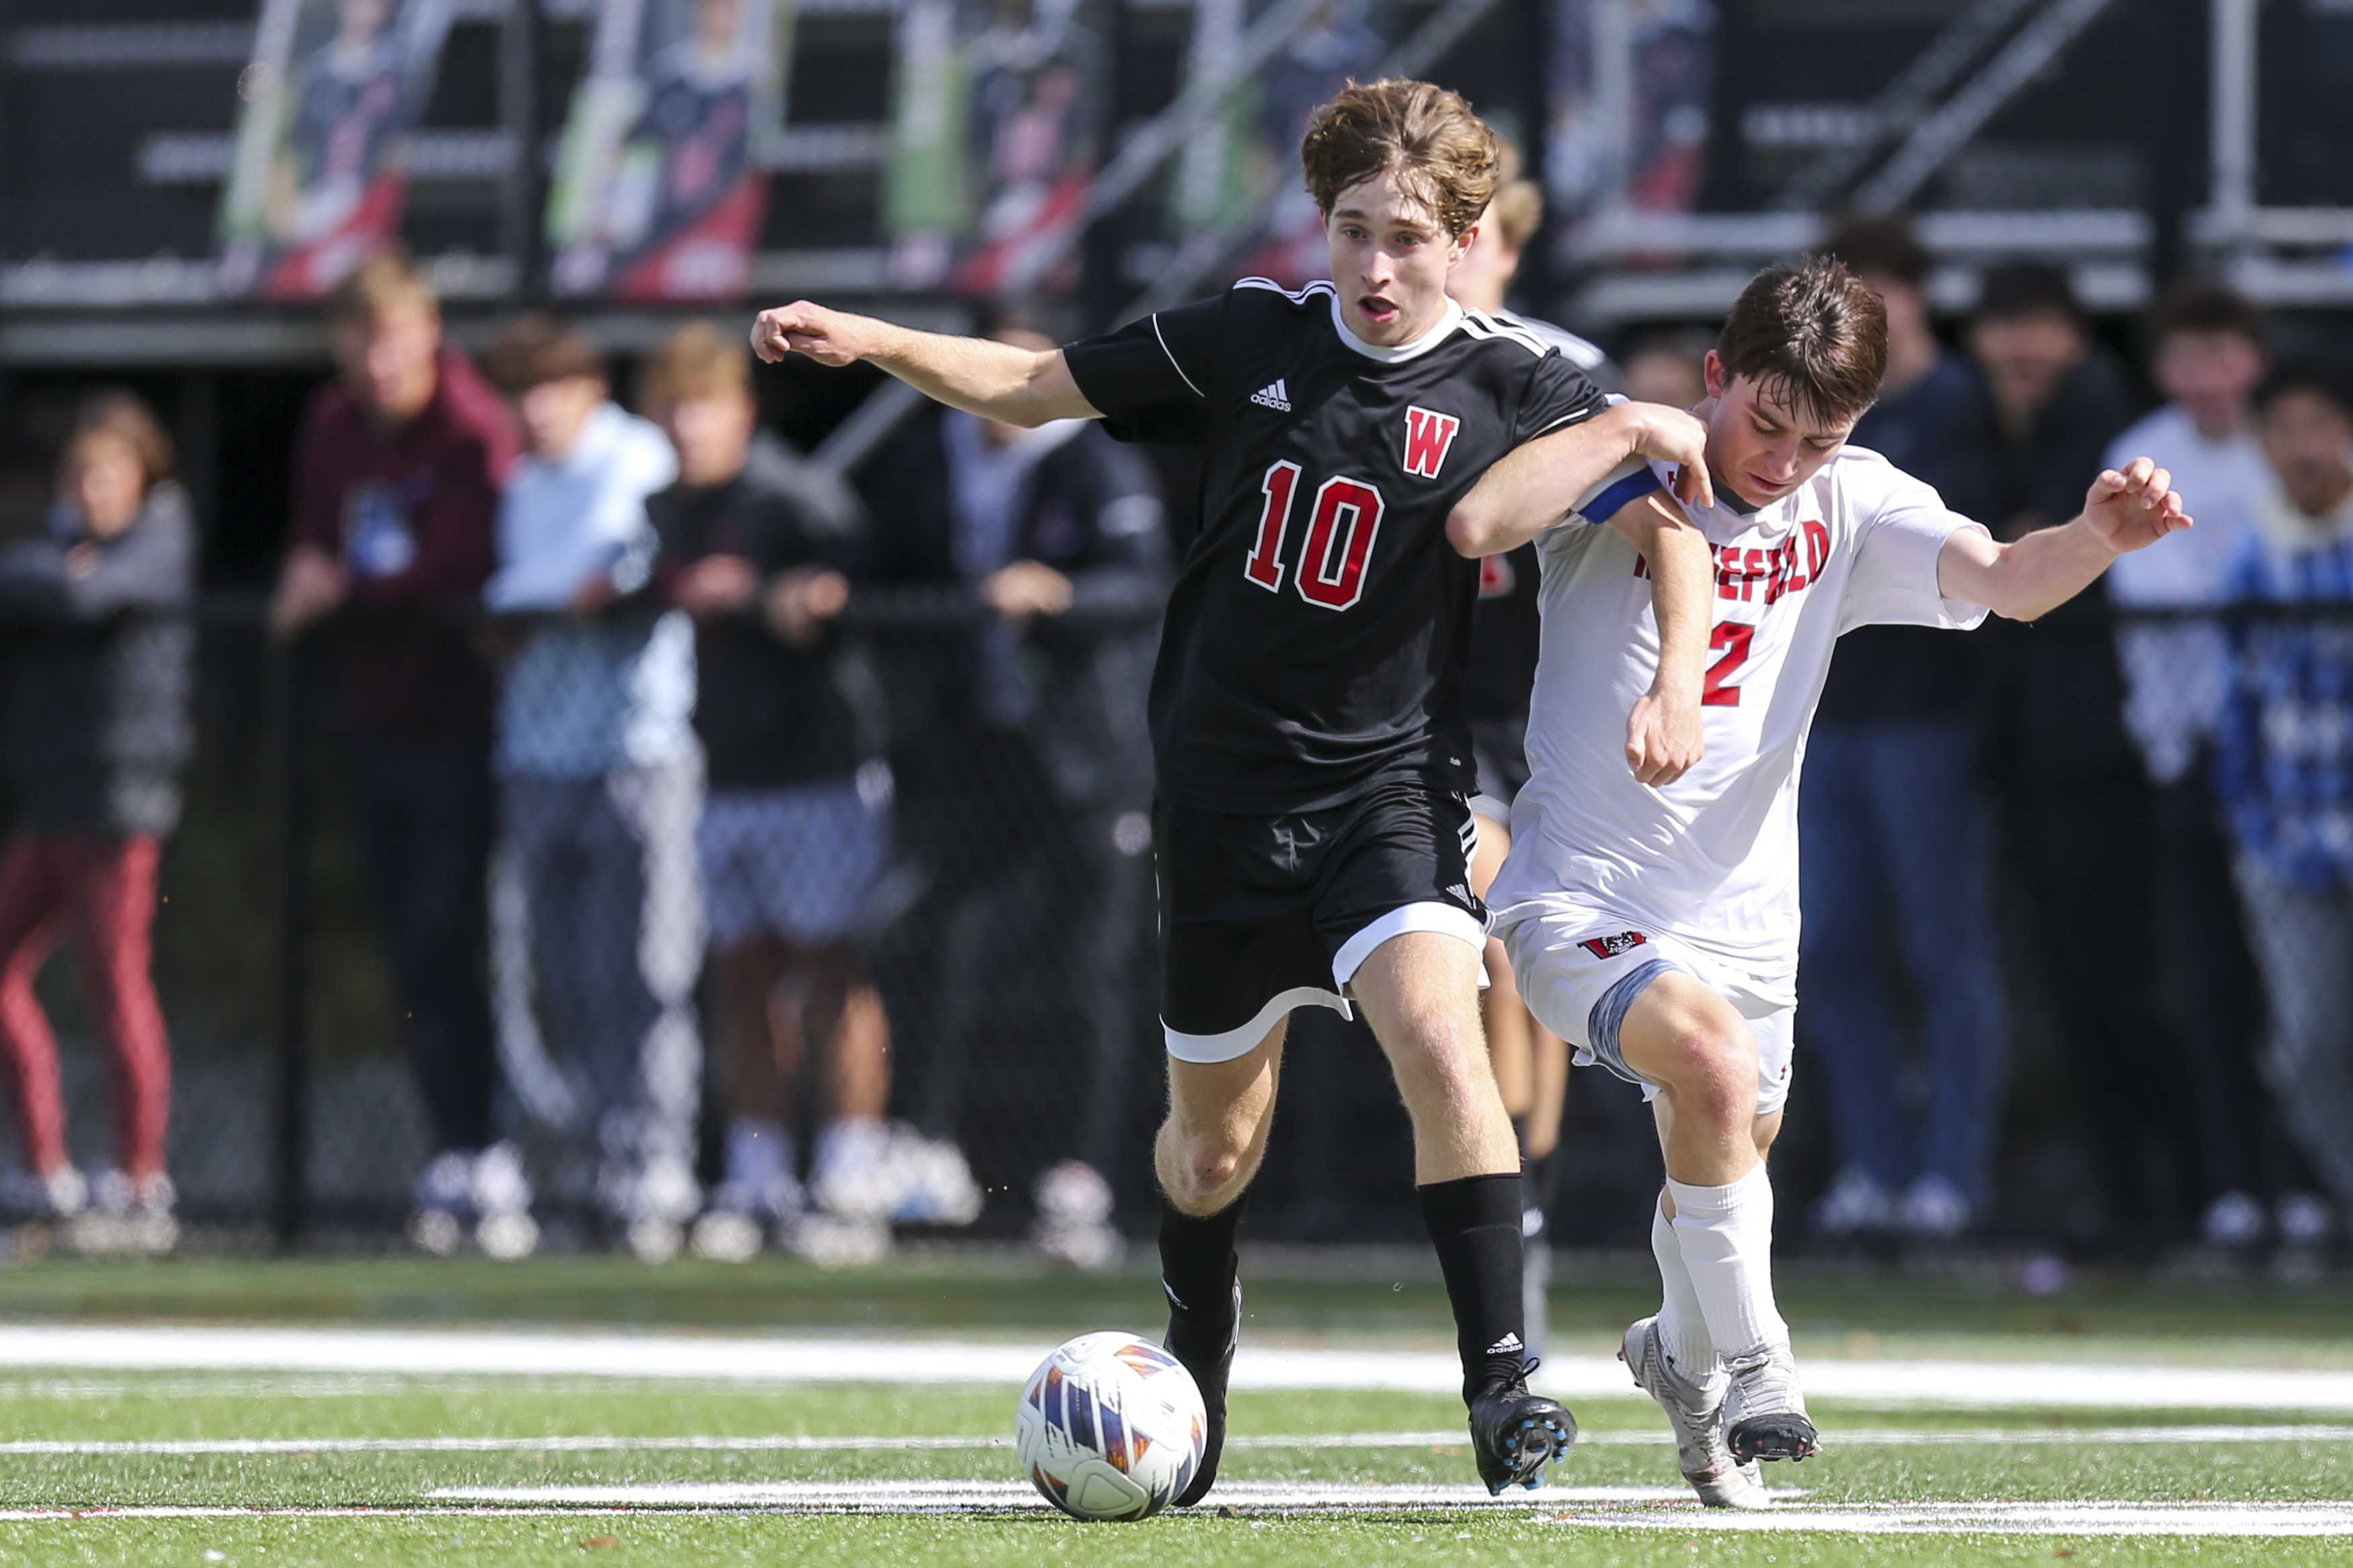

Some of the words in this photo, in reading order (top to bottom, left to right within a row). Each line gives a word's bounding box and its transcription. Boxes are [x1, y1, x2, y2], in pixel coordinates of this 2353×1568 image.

[1250, 394, 1291, 412] adidas
[1403, 405, 1460, 479] W
[1244, 459, 1385, 612] 10
[1702, 620, 1755, 707] 2
